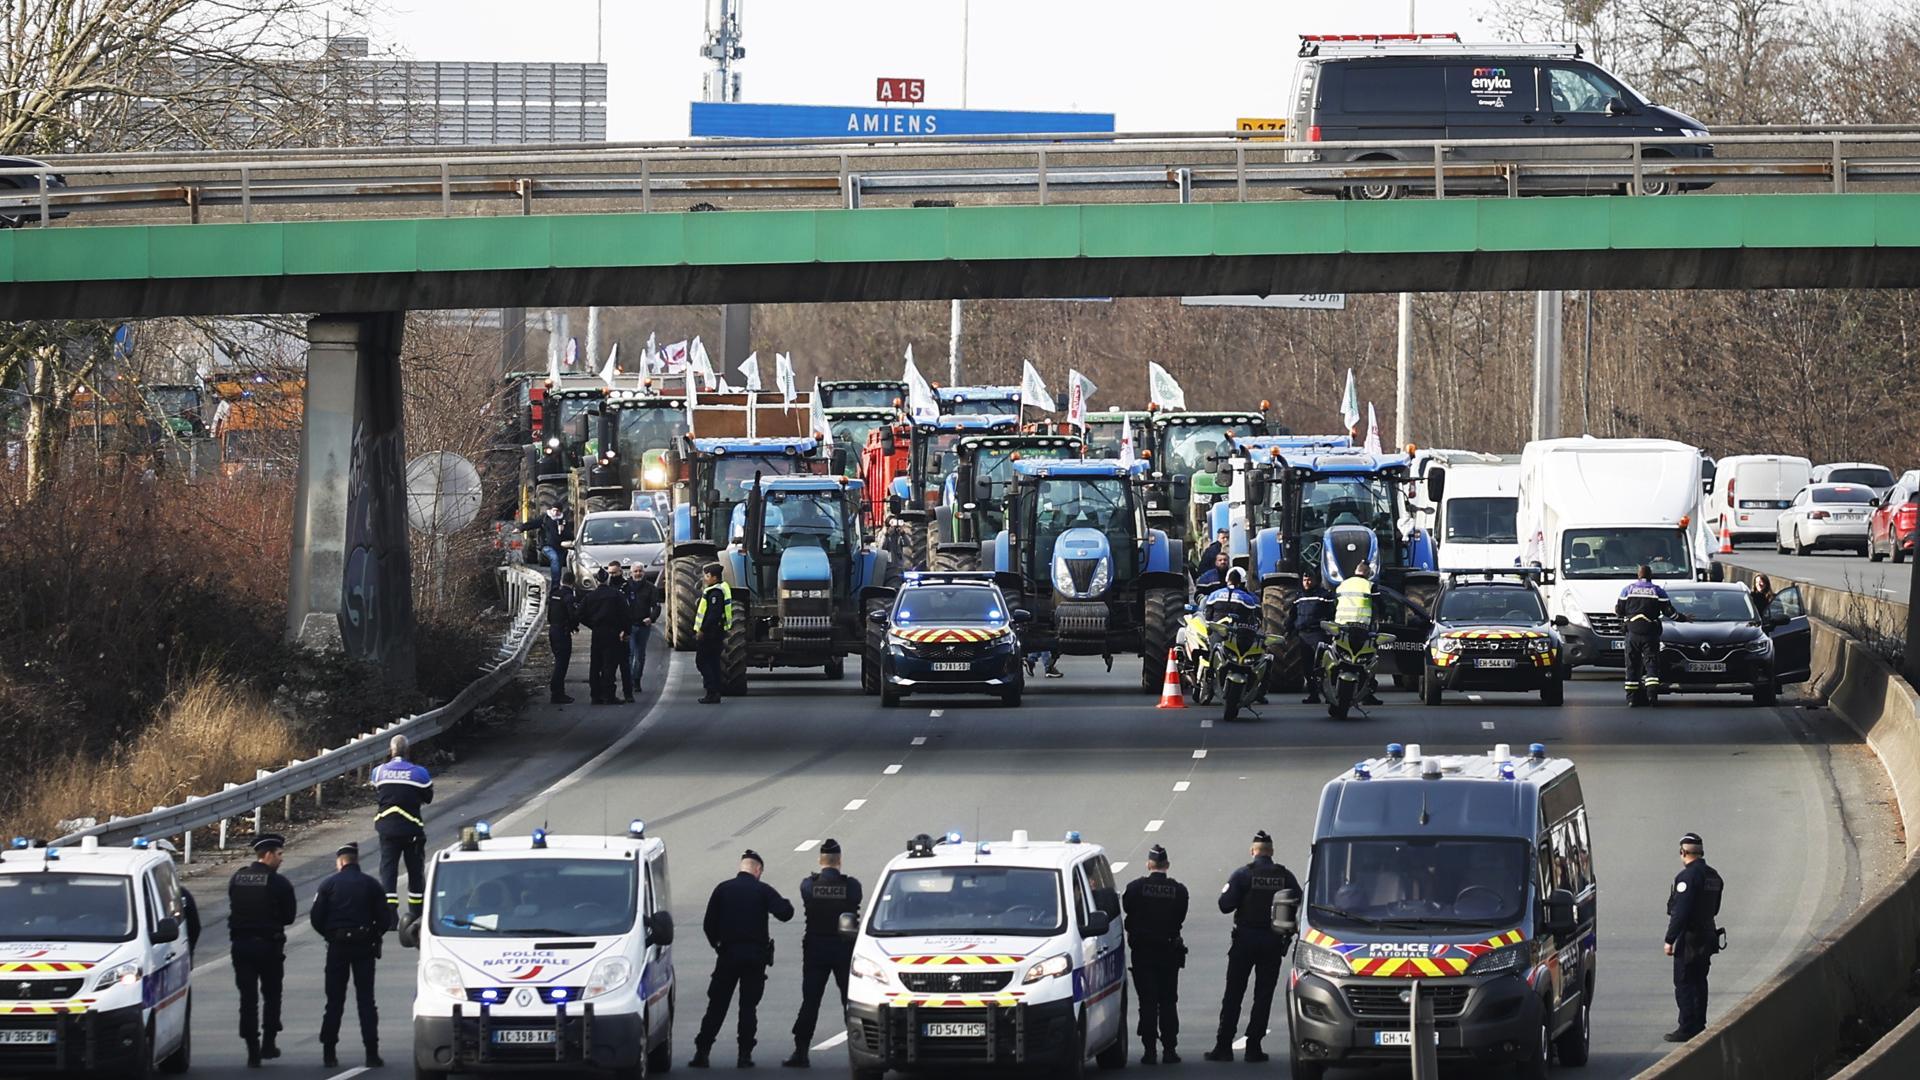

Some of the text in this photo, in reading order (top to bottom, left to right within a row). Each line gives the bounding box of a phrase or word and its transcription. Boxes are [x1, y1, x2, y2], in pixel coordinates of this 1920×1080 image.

[1471, 76, 1511, 91] enyka
[881, 81, 922, 100] A 15
[847, 113, 937, 133] AMIENS
[1378, 641, 1424, 652] NDARMERIE
[383, 770, 412, 780] POLICE
[1253, 878, 1284, 888] POLICE
[814, 887, 845, 896] POLICE
[1370, 943, 1430, 952] POLICE
[483, 958, 570, 966] NATIONALE
